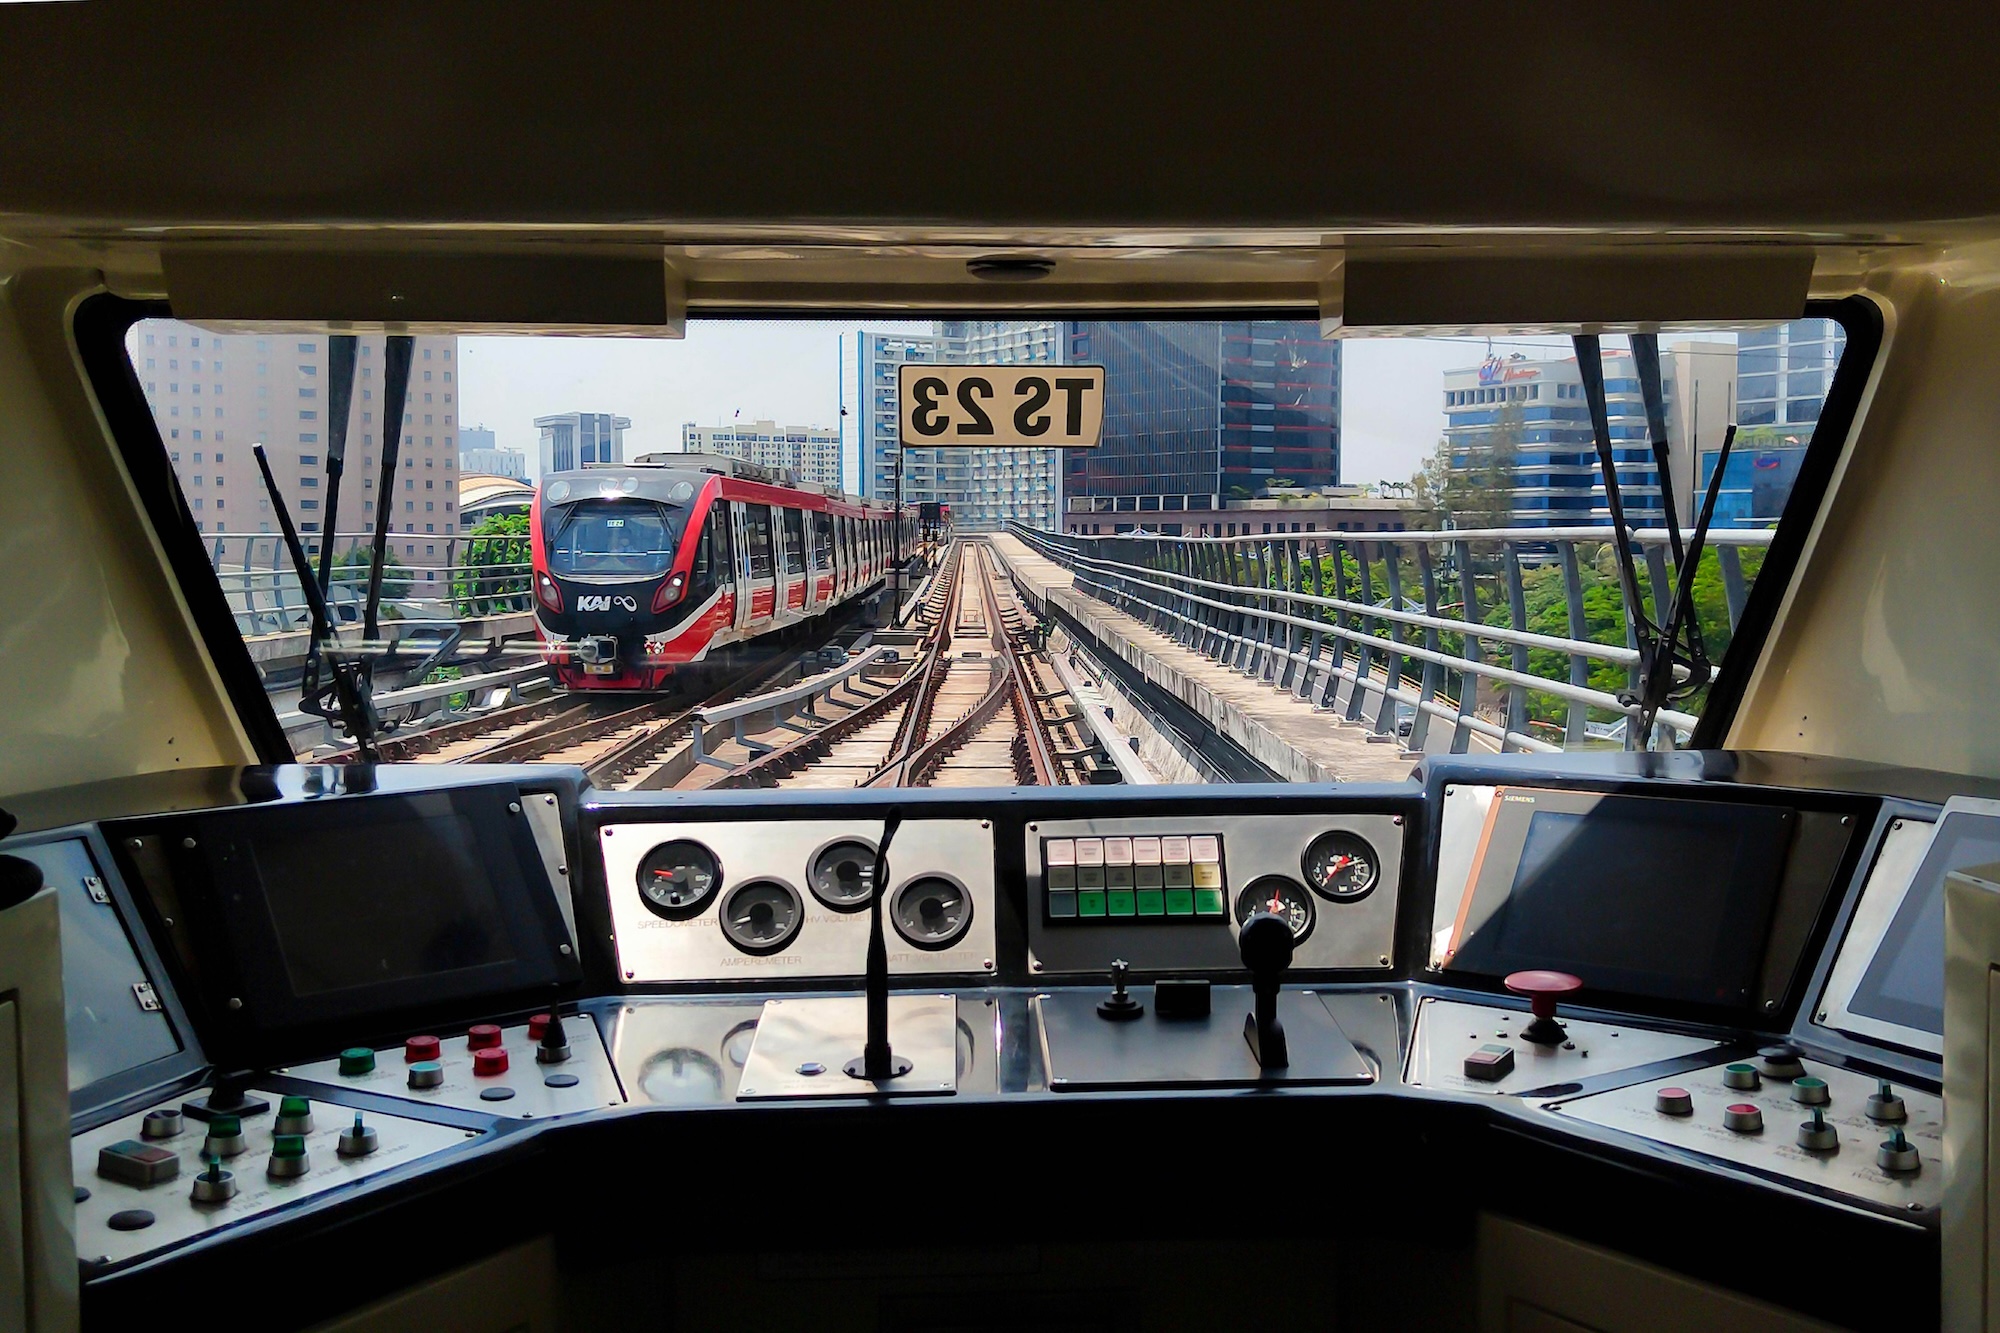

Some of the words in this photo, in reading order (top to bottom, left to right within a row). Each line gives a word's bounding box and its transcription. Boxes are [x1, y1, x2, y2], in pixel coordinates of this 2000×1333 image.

[577, 595, 612, 612] KAI
[1504, 795, 1536, 804] SIEMENS
[638, 917, 718, 929] SPEEDOMETER
[806, 916, 821, 924] HV
[824, 914, 886, 923] VOLTMETR
[720, 956, 802, 967] AMPEREMETER
